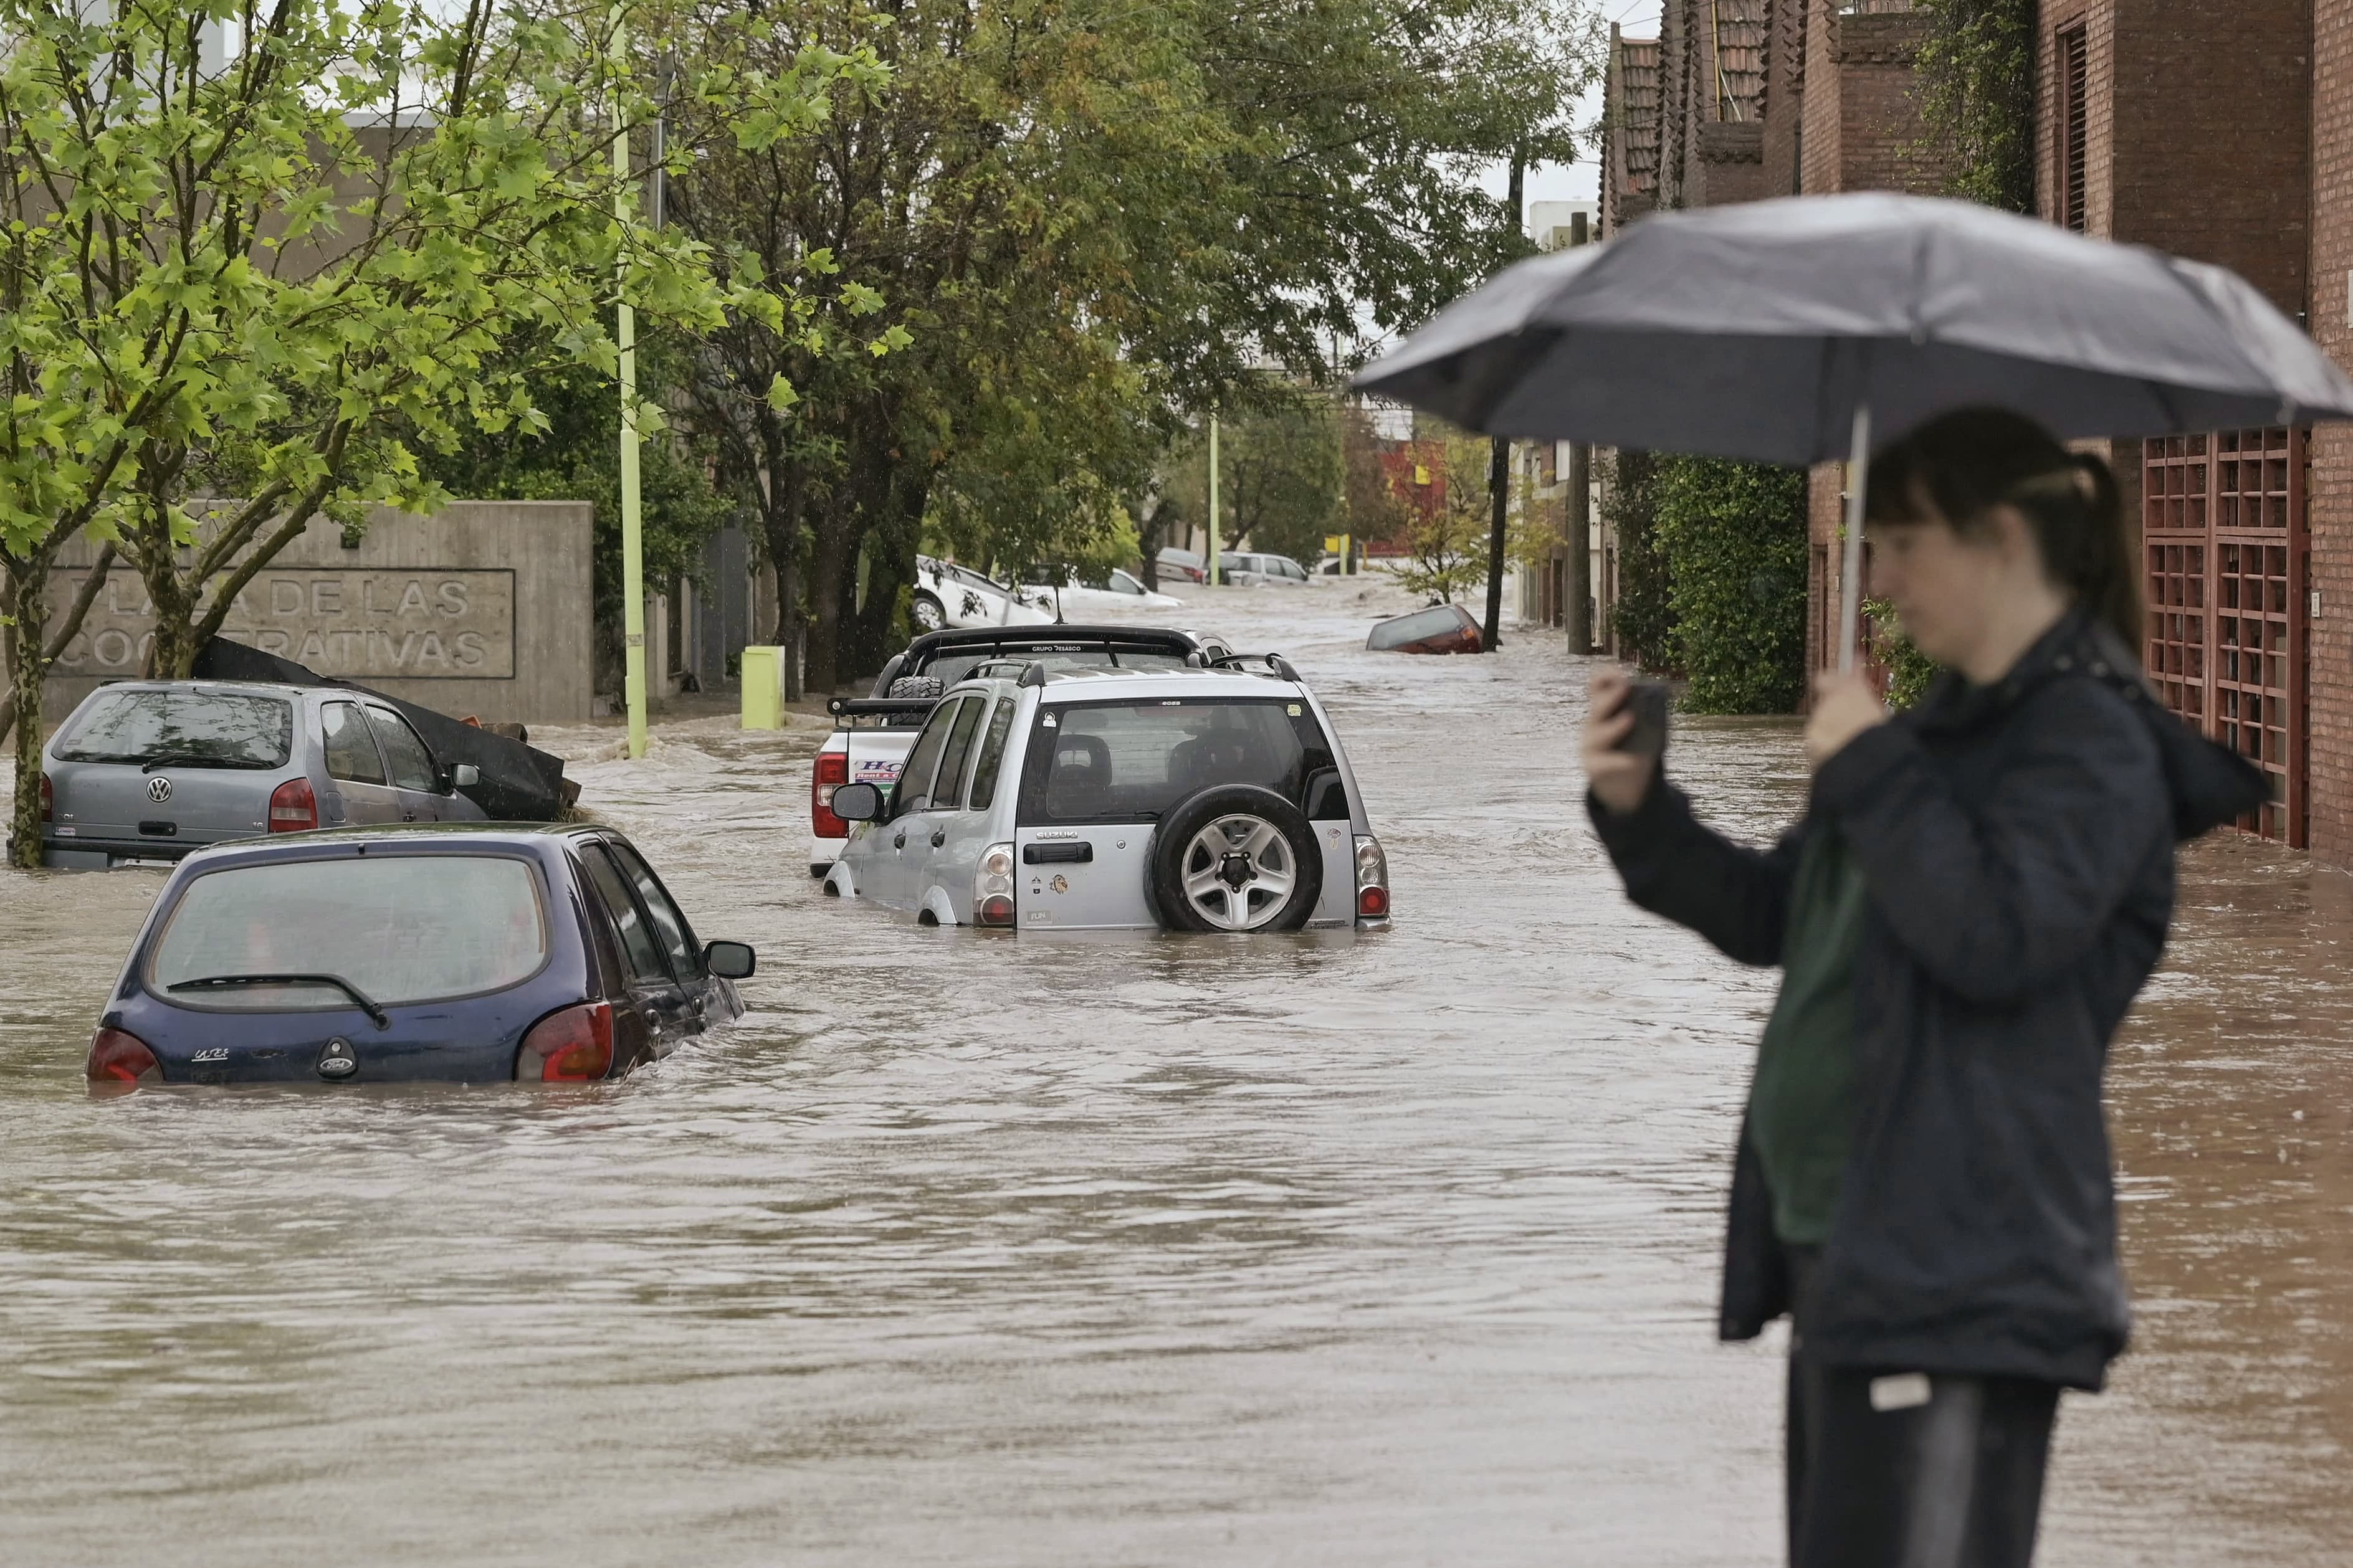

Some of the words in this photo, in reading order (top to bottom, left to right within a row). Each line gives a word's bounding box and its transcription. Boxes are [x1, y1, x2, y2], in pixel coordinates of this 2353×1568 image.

[270, 579, 343, 617] DE
[363, 579, 469, 618] LAS
[1036, 831, 1078, 840] SUZUKI
